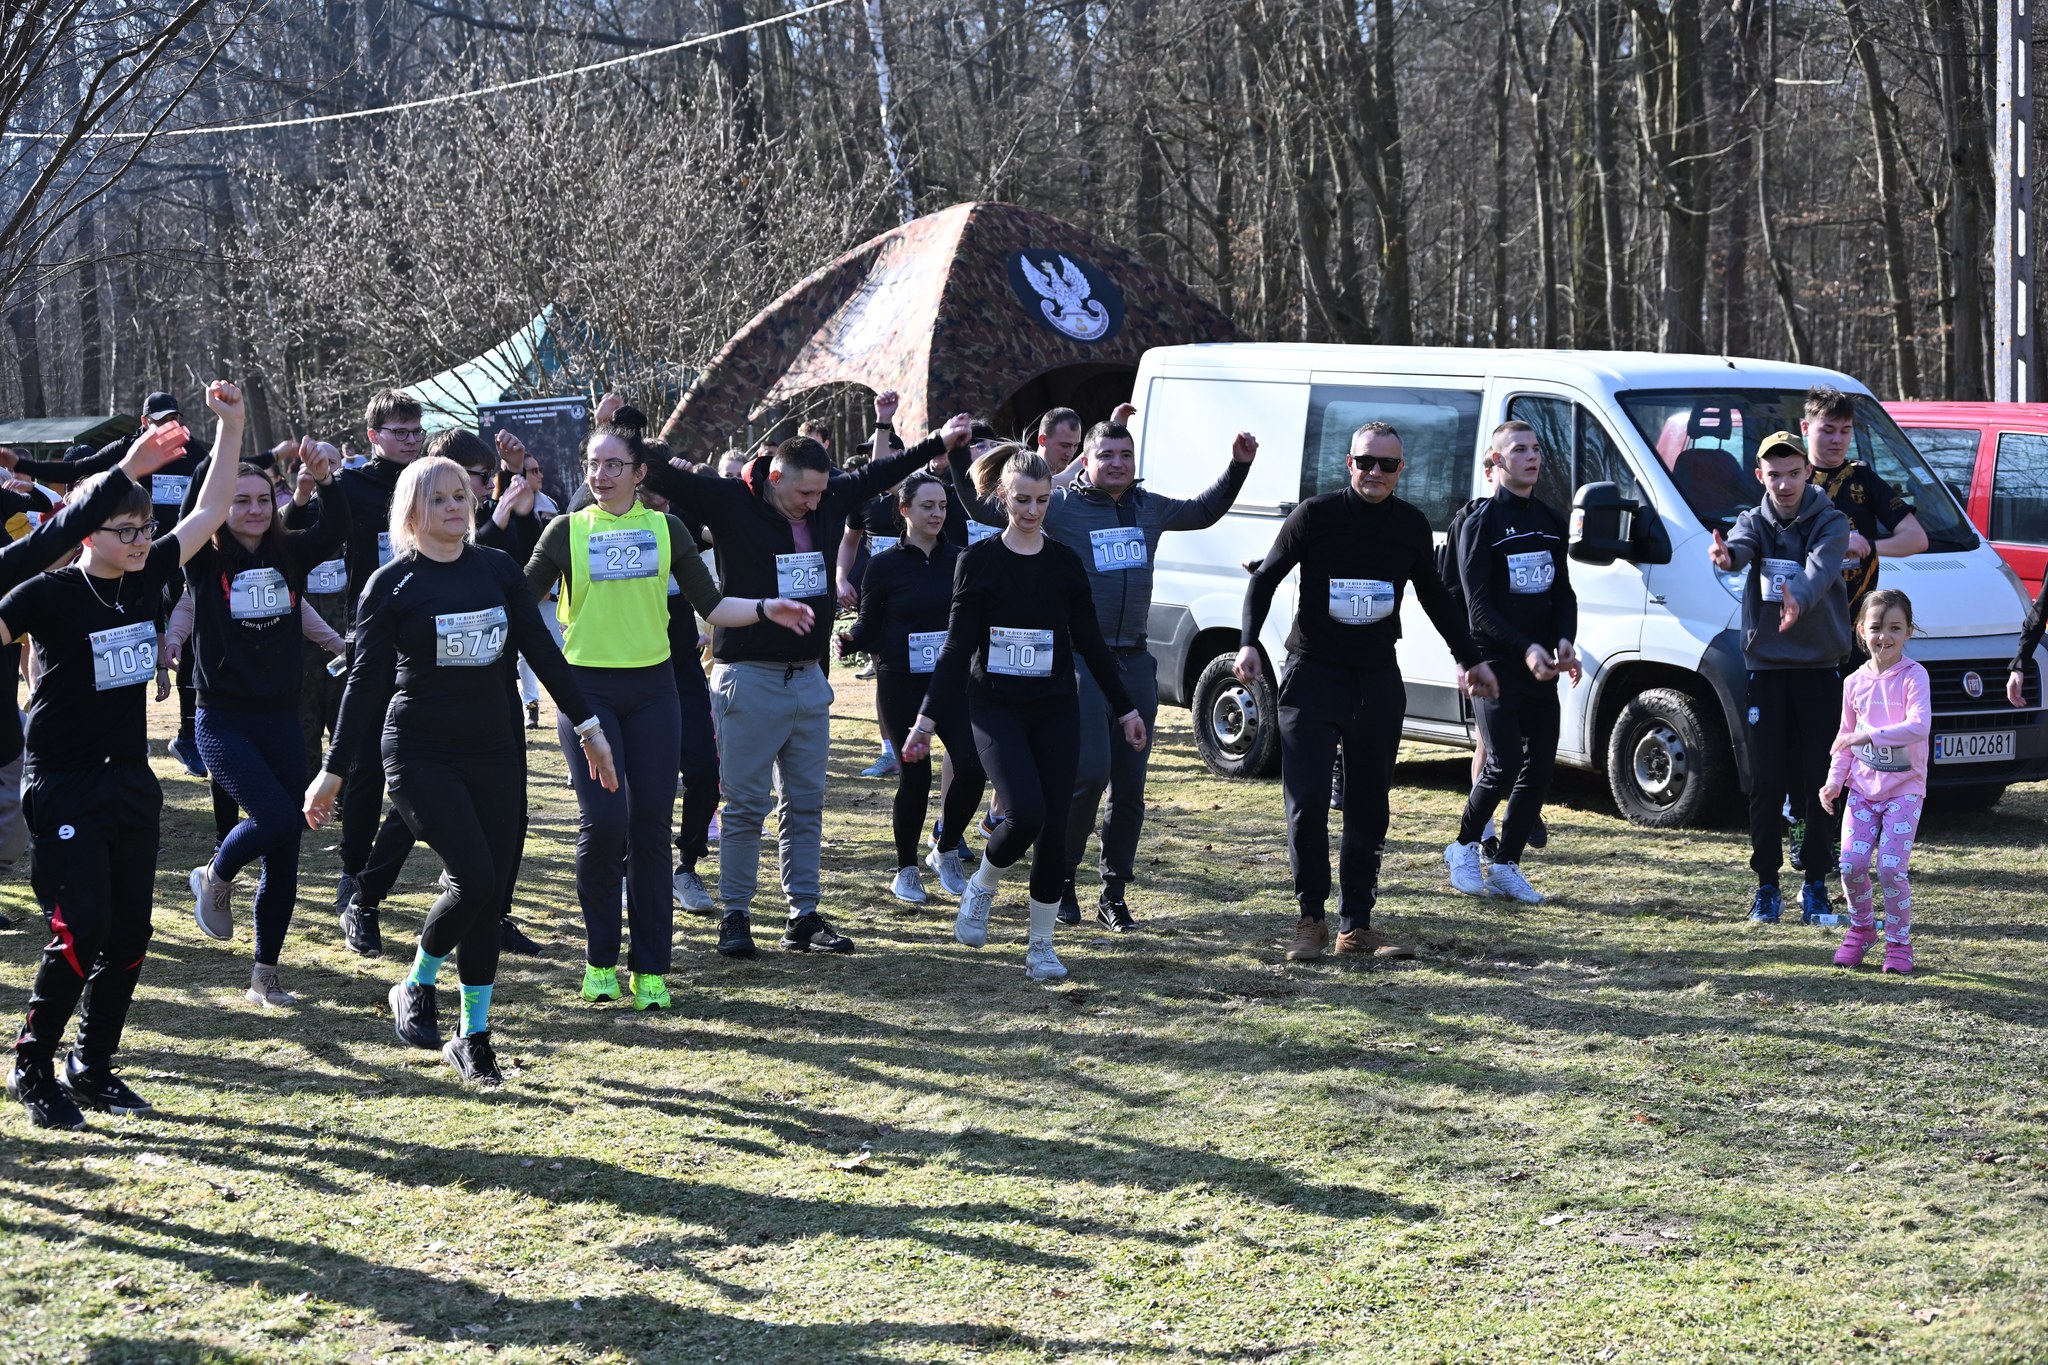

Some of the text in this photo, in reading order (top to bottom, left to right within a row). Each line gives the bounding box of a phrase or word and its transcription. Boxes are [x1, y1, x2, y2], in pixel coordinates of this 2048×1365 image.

[162, 484, 182, 499] 79
[606, 545, 643, 571] 22
[1100, 541, 1142, 563] 100
[319, 571, 339, 587] 51
[792, 568, 819, 590] 25
[1515, 564, 1552, 587] 542
[1772, 573, 1787, 594] 8
[248, 584, 278, 609] 16
[1350, 595, 1373, 617] 11
[446, 626, 502, 657] 574
[103, 642, 155, 677] 103
[1006, 644, 1036, 668] 10
[1968, 679, 1980, 691] FIAT
[1861, 742, 1894, 764] 49
[1944, 734, 2011, 757] UA 02681
